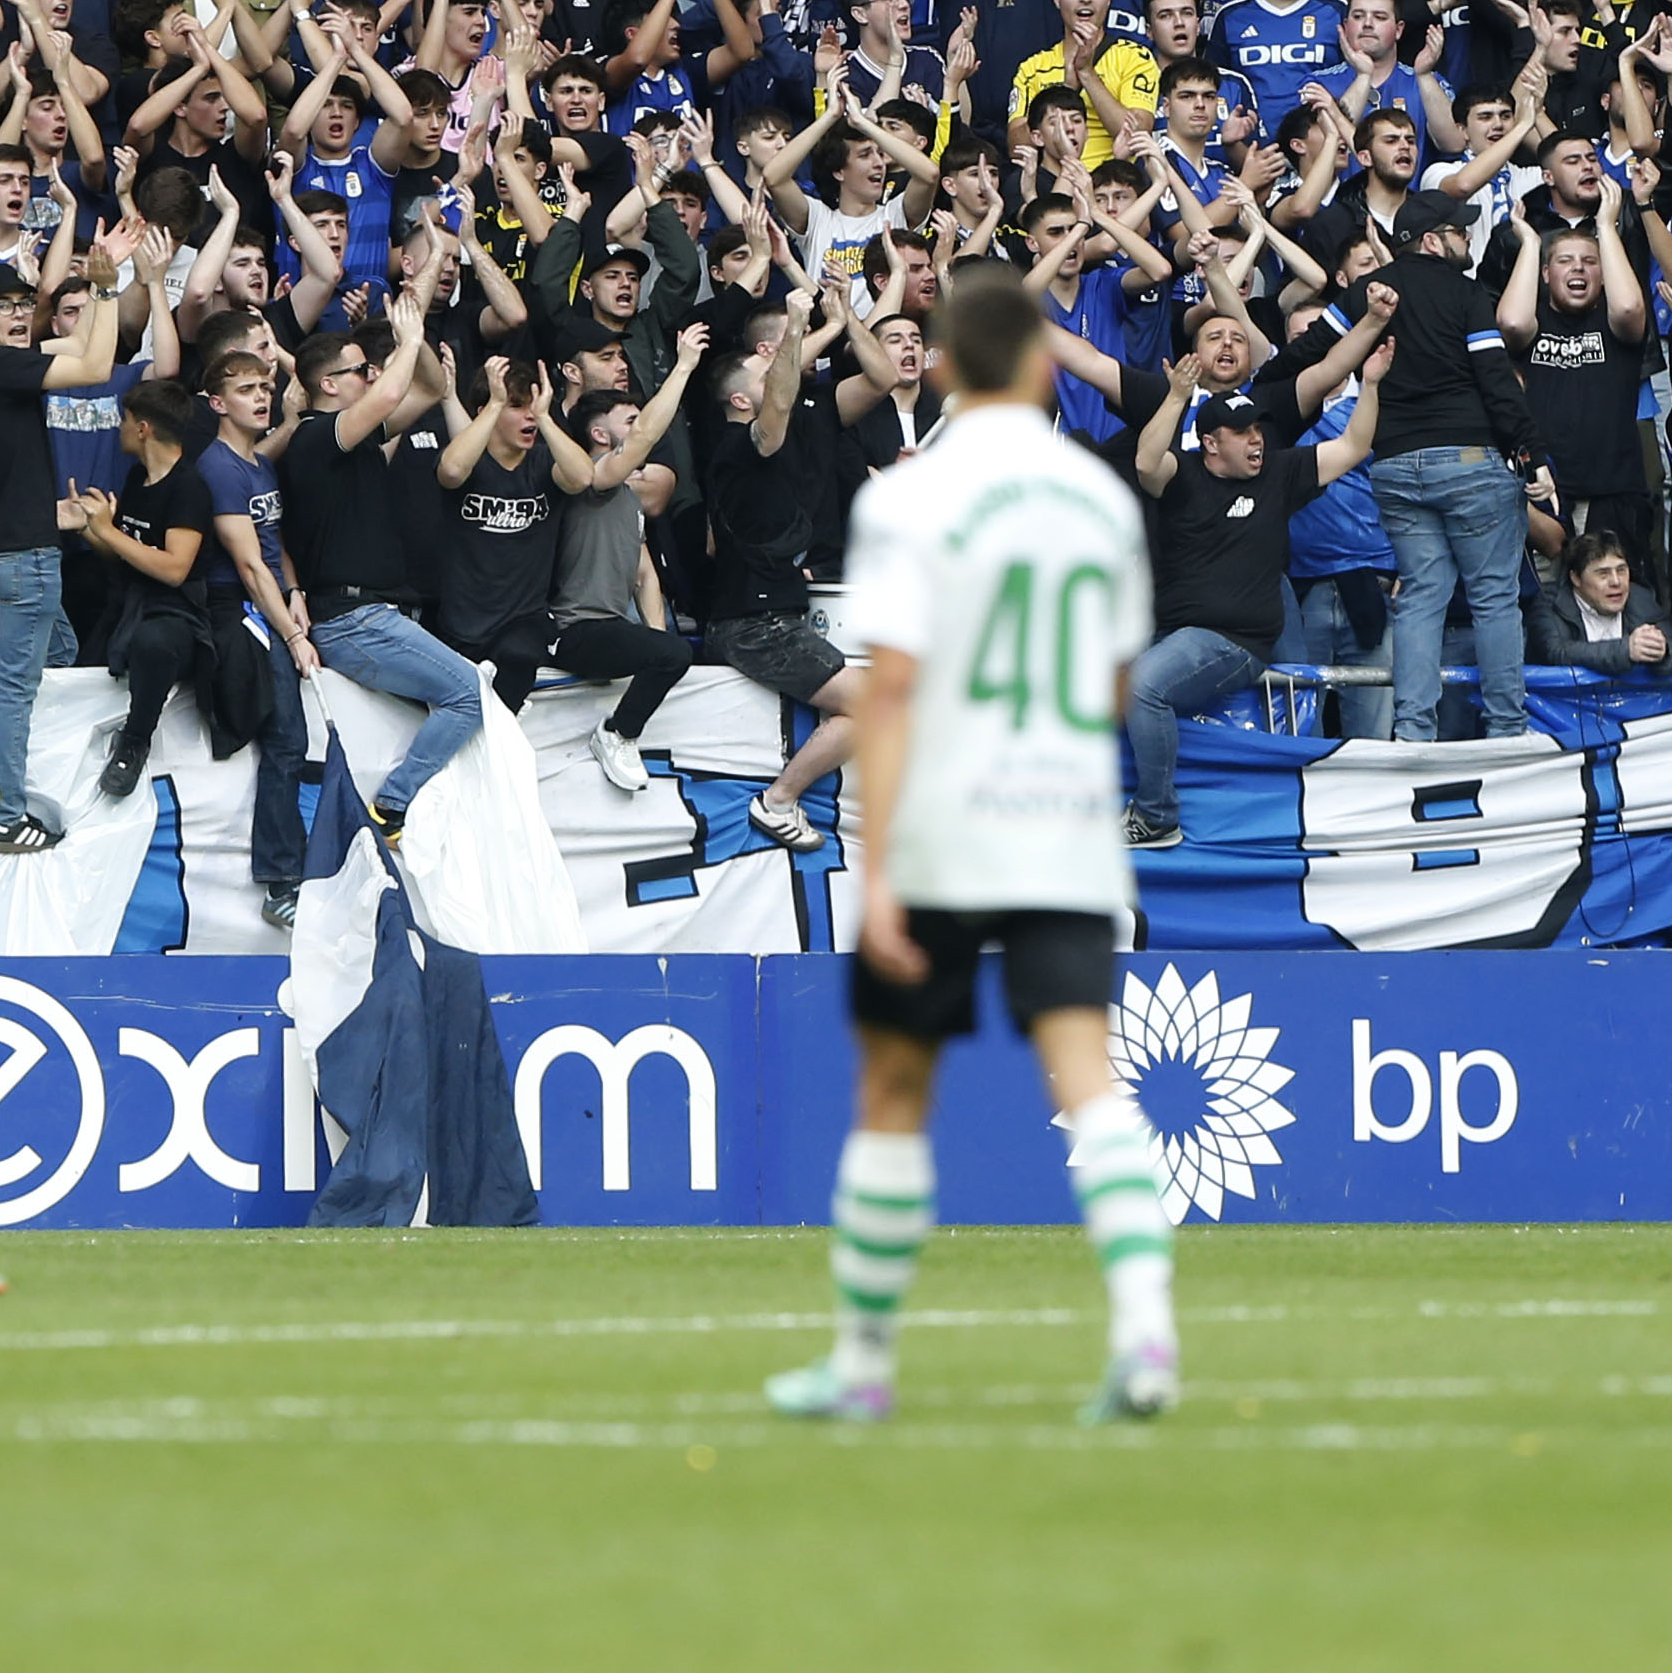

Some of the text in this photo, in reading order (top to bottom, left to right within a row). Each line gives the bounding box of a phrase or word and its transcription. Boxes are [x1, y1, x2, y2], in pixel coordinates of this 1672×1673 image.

[1238, 43, 1326, 68] DIGI
[968, 563, 1120, 735] 40
[1351, 1017, 1520, 1174] bp
